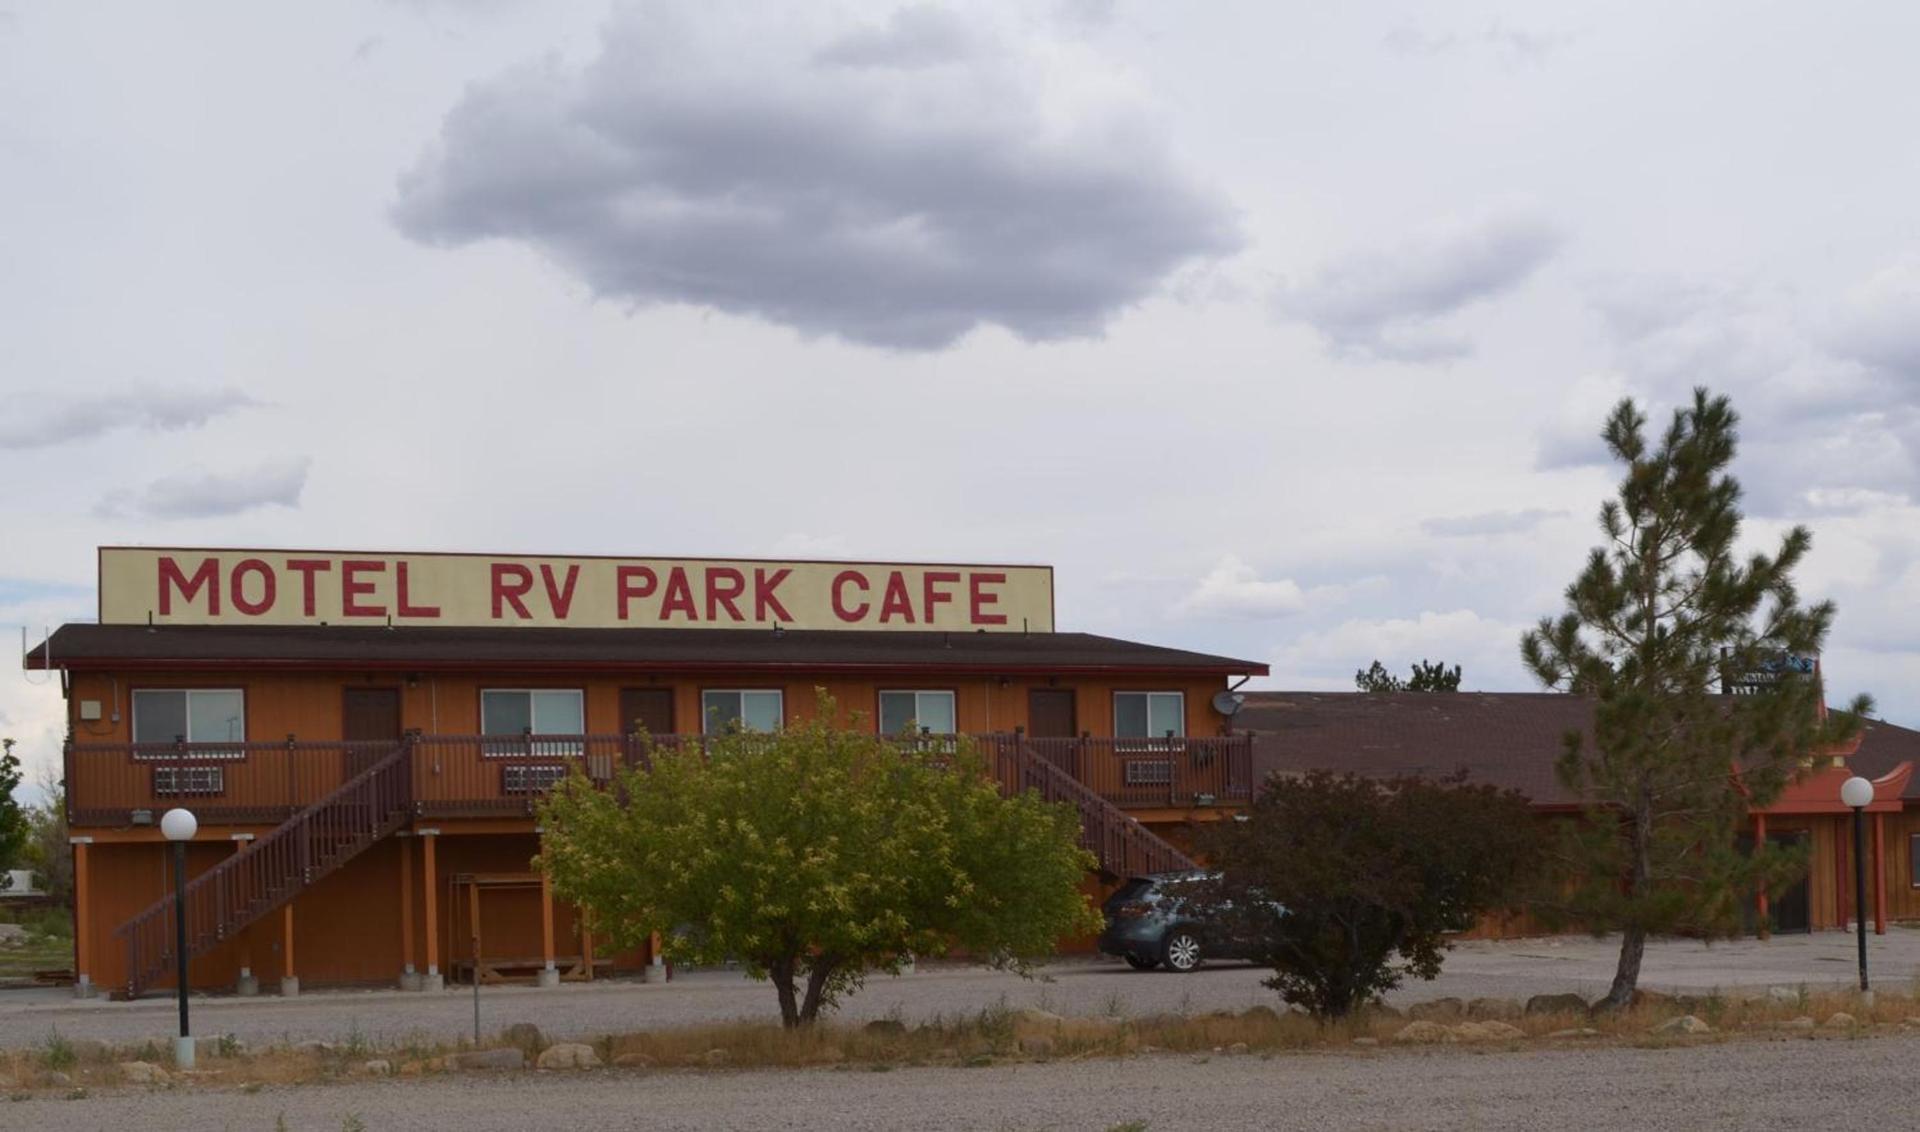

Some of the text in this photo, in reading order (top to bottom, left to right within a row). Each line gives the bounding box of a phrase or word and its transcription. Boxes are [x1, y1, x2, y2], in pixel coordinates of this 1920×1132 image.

[158, 558, 1007, 624] MOTEL RV PARK CAFE
